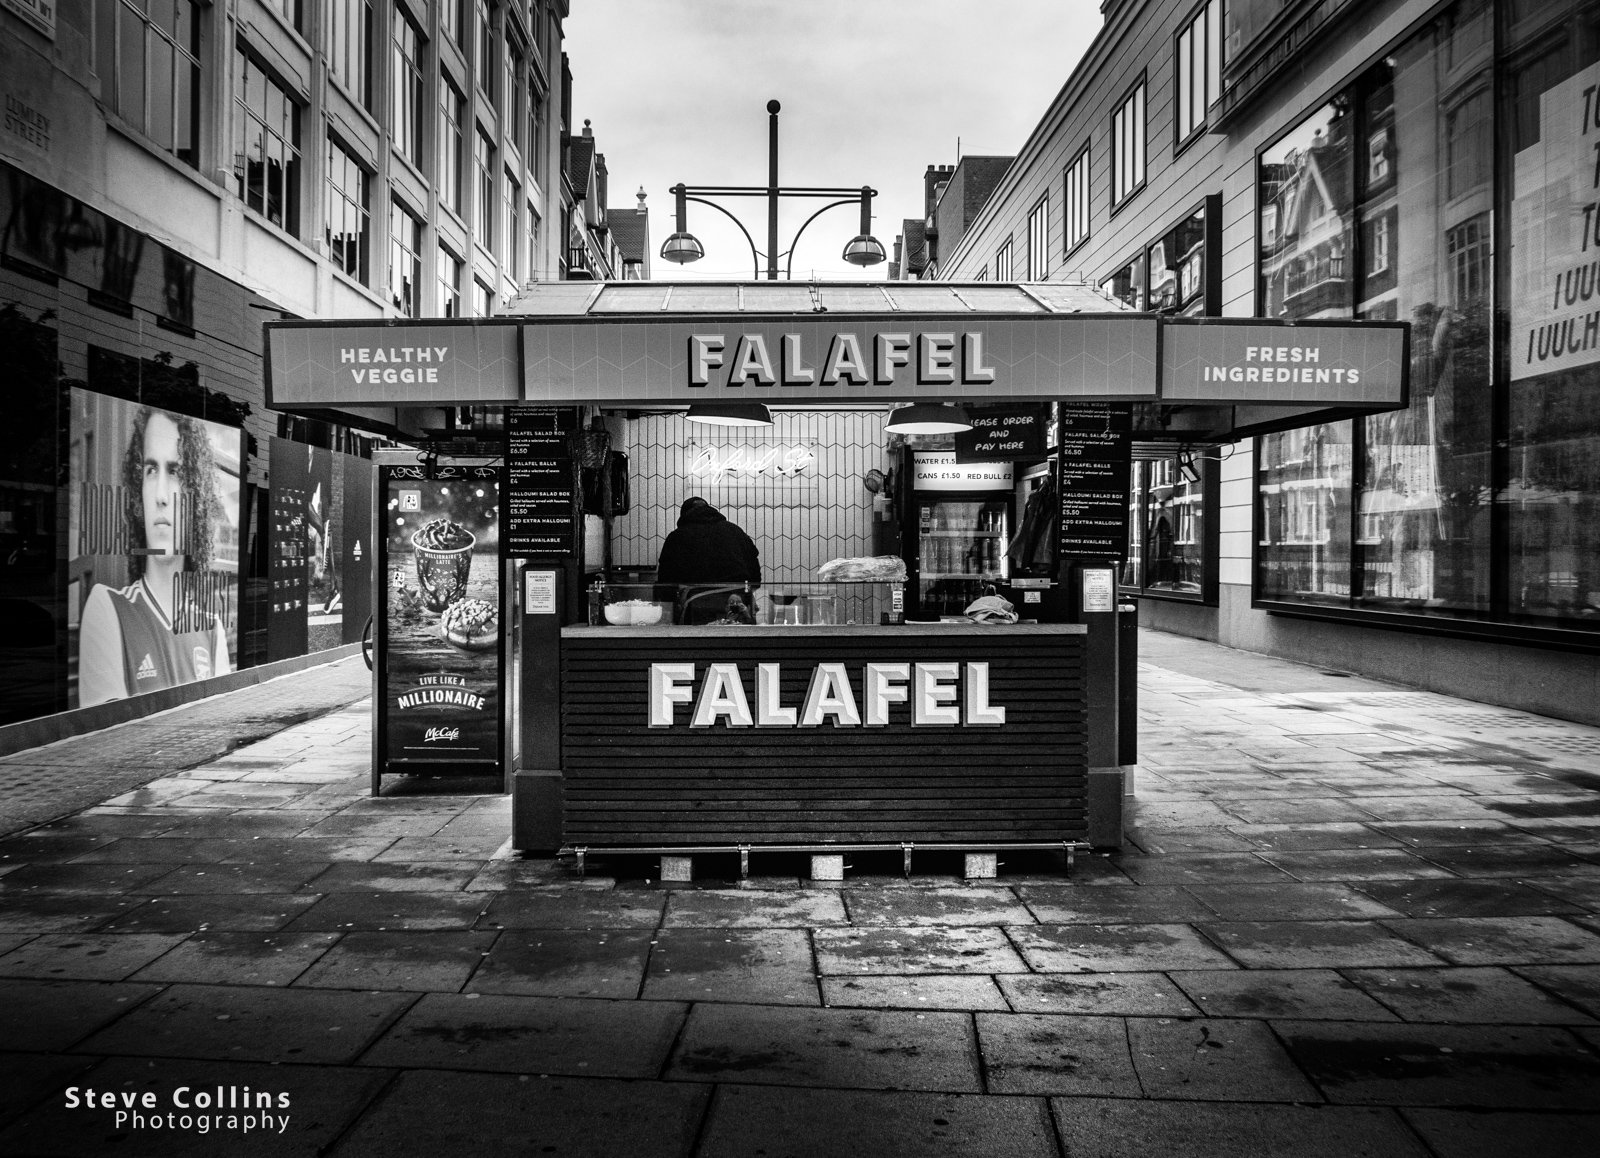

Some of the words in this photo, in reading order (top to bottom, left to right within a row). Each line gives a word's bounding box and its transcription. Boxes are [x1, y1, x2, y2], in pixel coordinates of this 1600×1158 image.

[5, 114, 50, 151] STREET
[341, 347, 448, 363] HEALTHY
[688, 332, 995, 388] FALAFEL
[1246, 346, 1320, 362] FRESH
[351, 368, 438, 384] VEGGIE
[1204, 366, 1360, 384] INGREDIENTS
[970, 418, 998, 427] LEASE
[1003, 416, 1034, 426] ORDER
[974, 443, 996, 451] PAY
[999, 442, 1024, 450] HERE
[692, 448, 778, 485] Oxford
[172, 571, 216, 635] OXFORD
[419, 676, 437, 686] LIVE
[440, 676, 457, 685] LIKE
[459, 678, 465, 686] A
[398, 690, 486, 710] MILLIONAIRE
[648, 662, 1006, 728] FALAFEL
